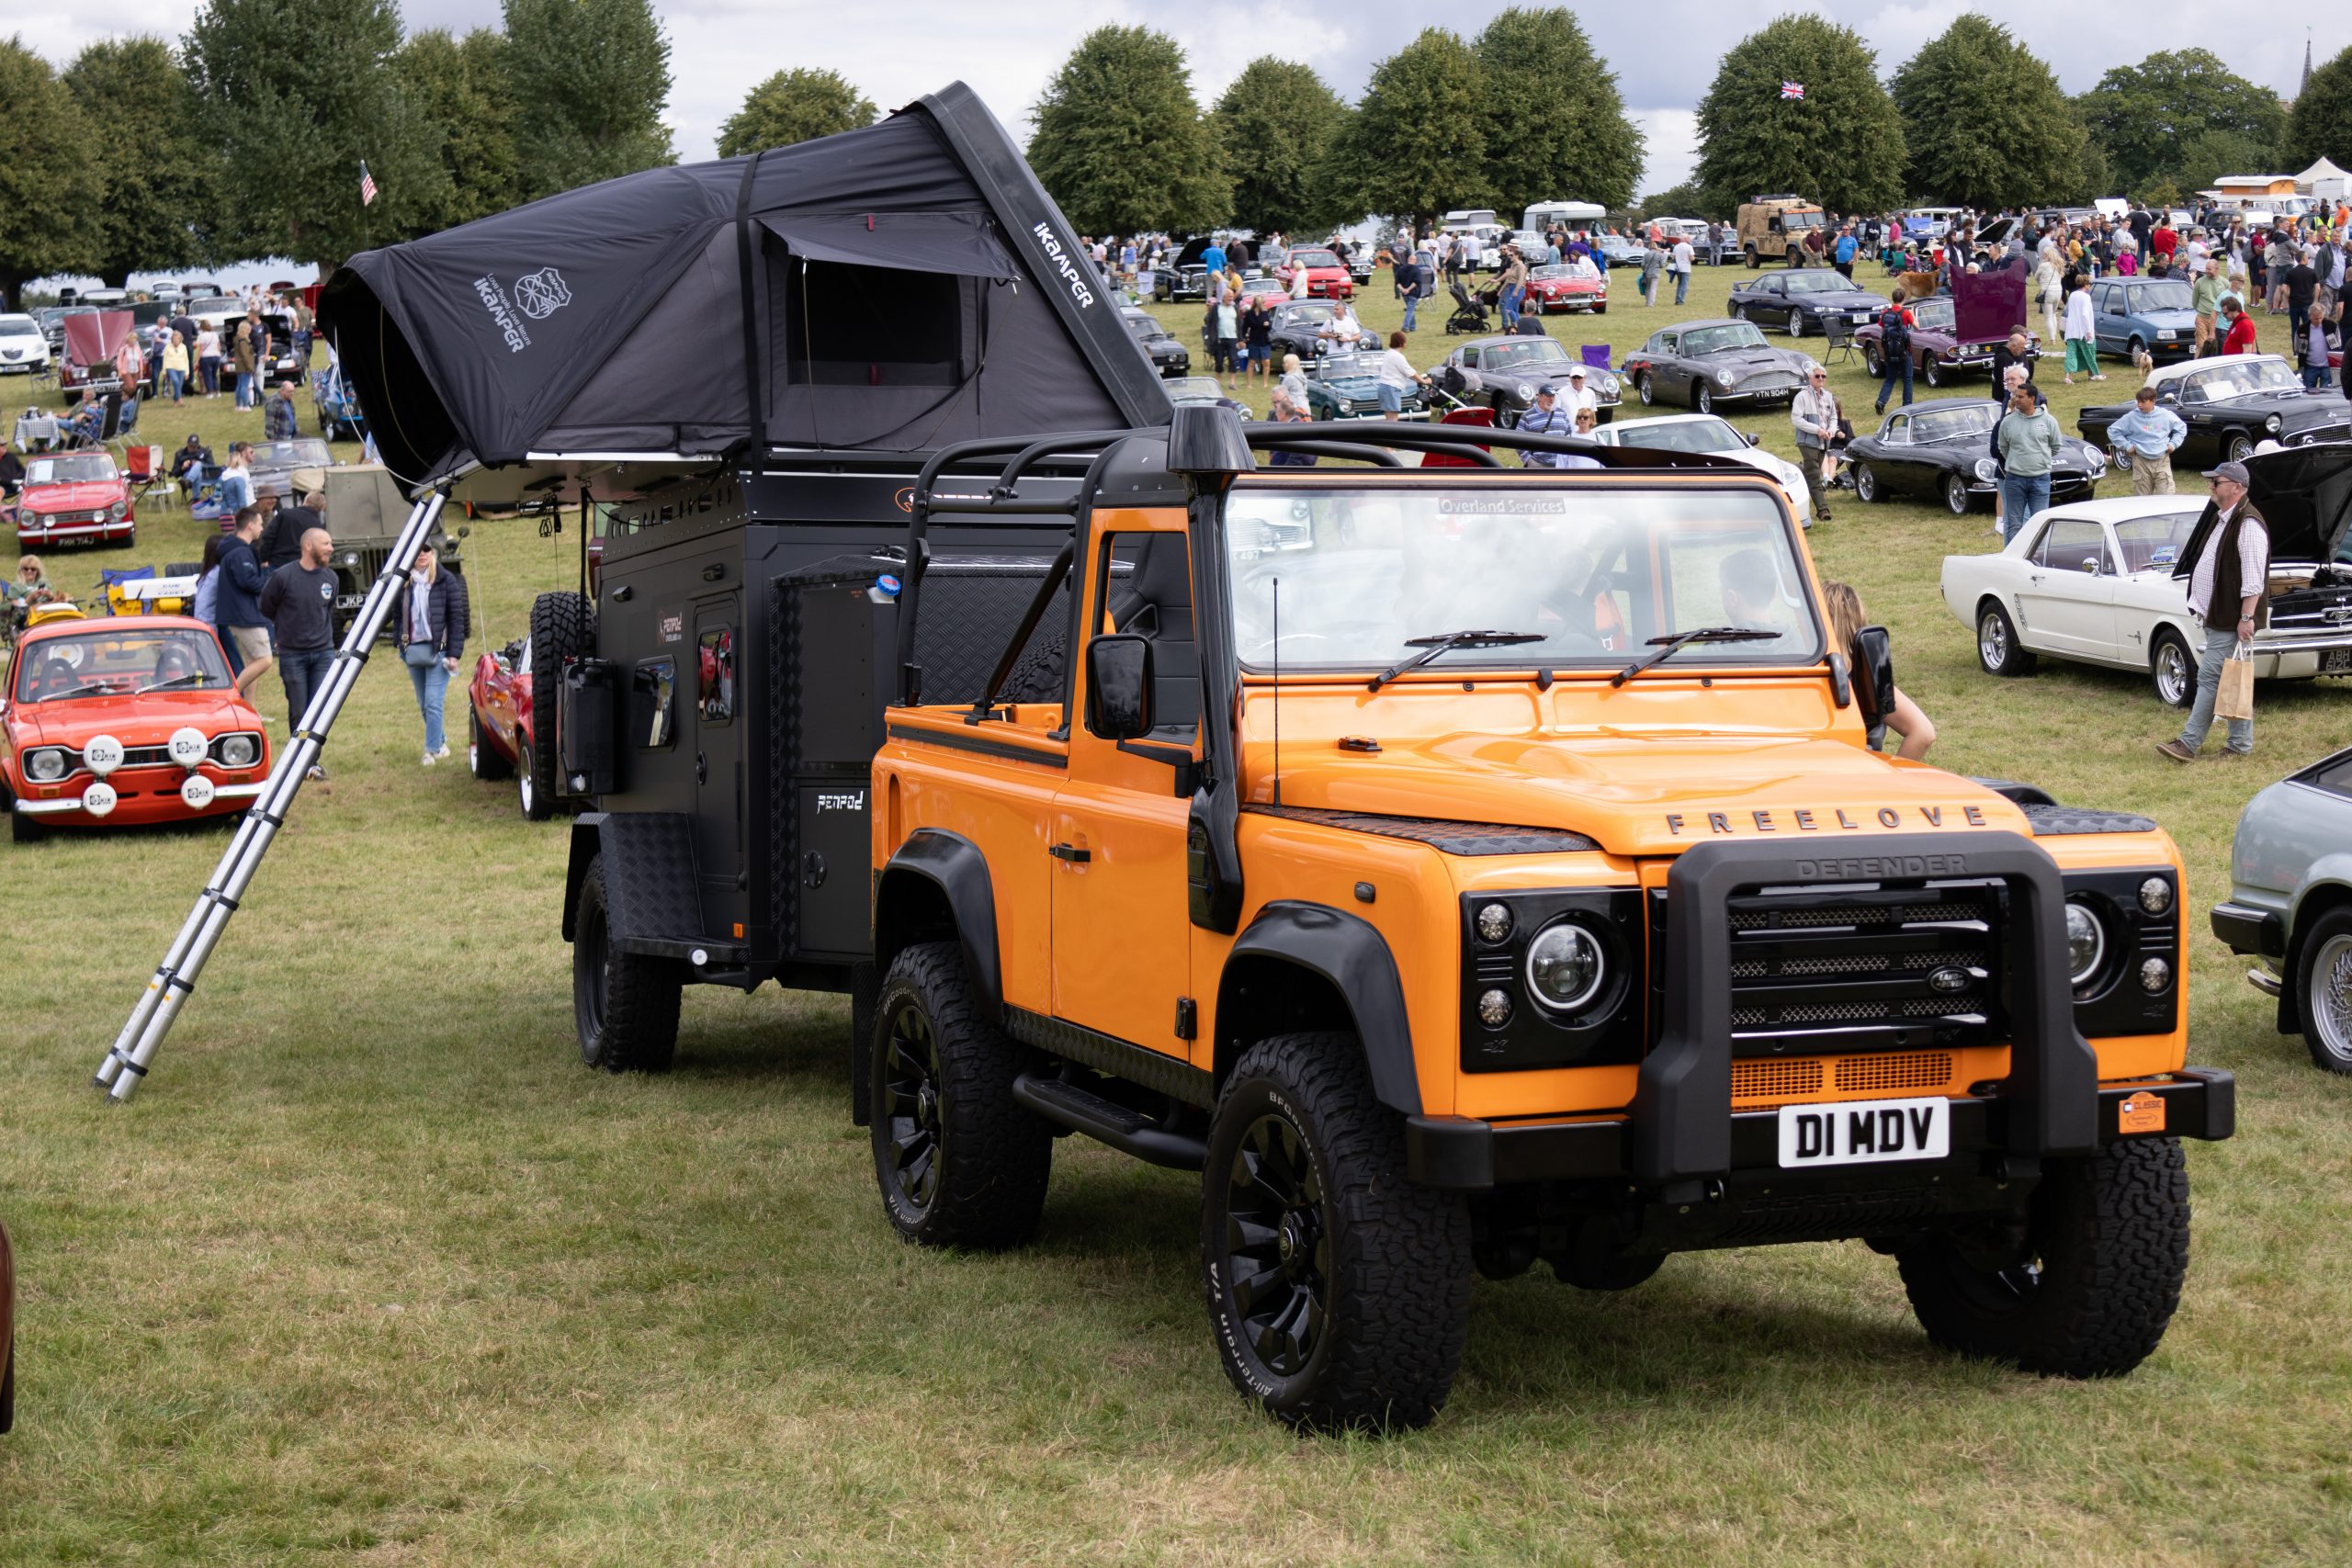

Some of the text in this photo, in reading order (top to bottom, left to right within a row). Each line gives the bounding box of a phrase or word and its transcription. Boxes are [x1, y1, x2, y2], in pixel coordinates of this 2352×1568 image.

[1441, 499, 1565, 513] Overland Services
[2328, 649, 2350, 660] ABH
[2325, 660, 2351, 671] 612C
[1796, 854, 1967, 879] DEFENDER
[1849, 1106, 1934, 1155] MDV
[1210, 1261, 1273, 1396] All-Terrain T/A
